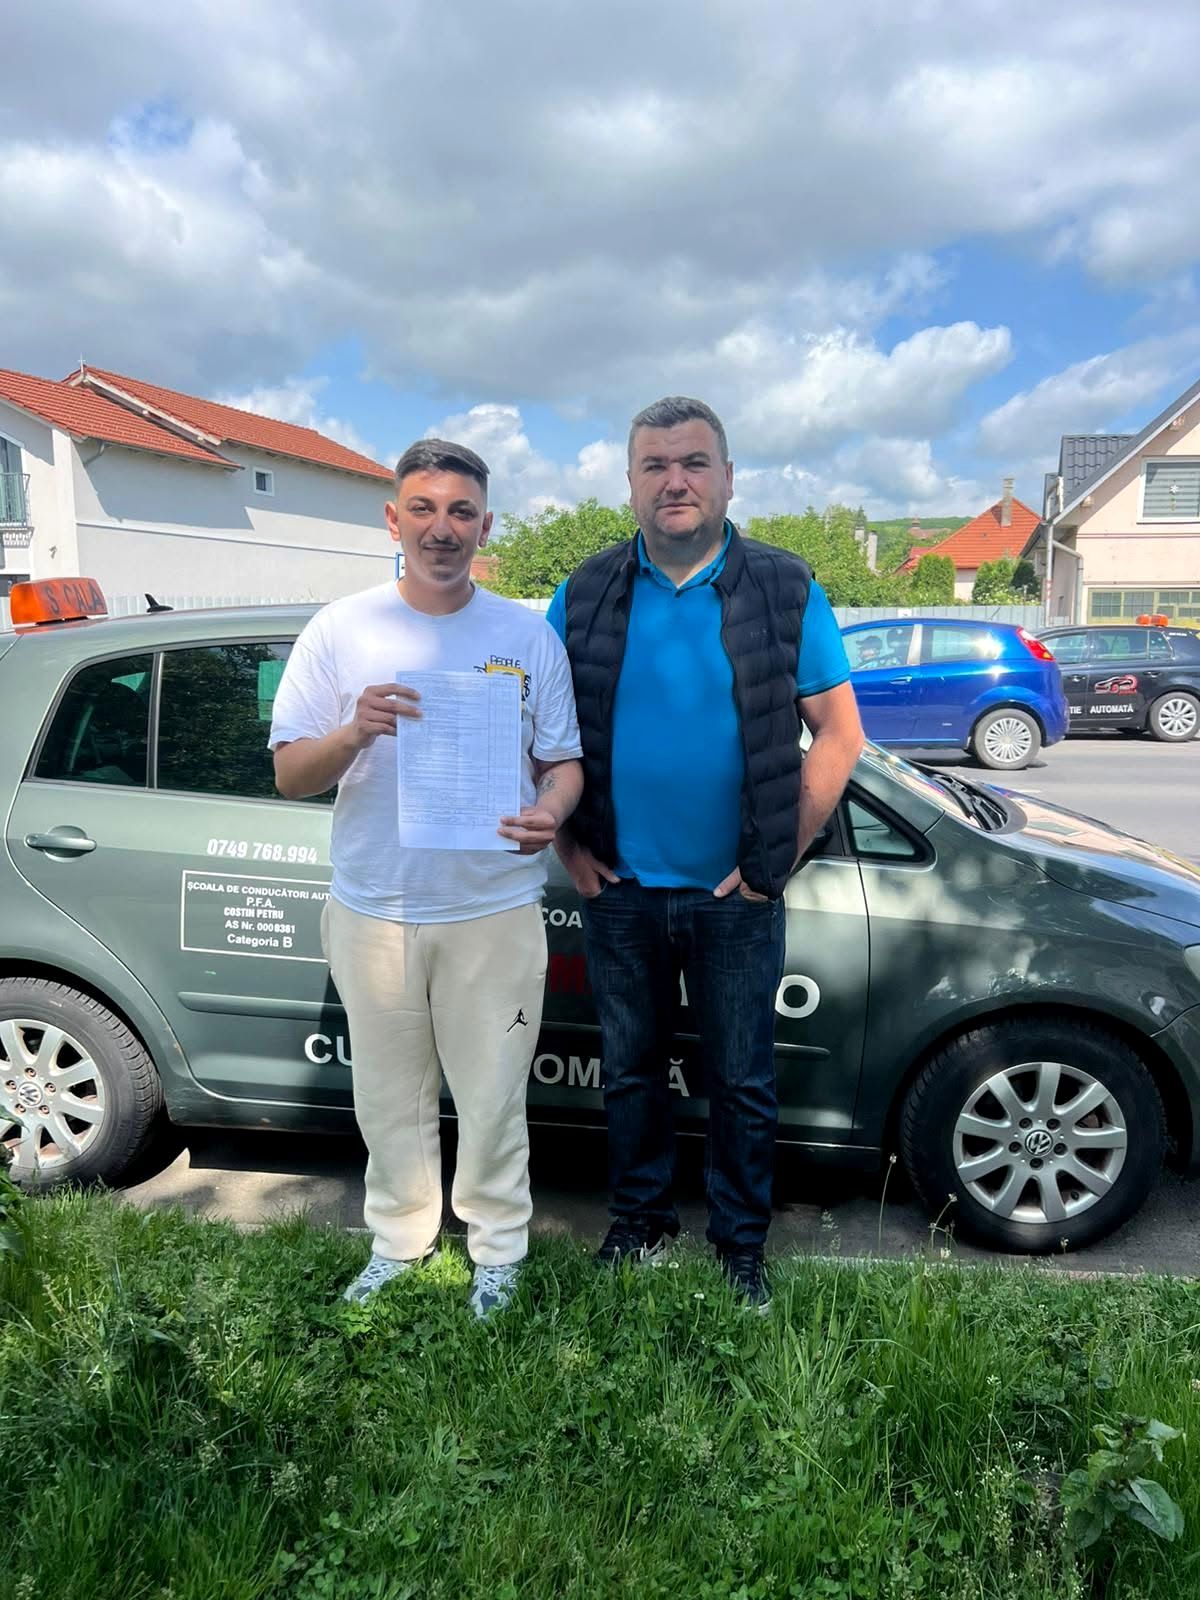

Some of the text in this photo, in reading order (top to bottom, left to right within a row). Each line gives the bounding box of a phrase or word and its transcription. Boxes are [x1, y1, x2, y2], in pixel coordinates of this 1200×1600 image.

[207, 838, 318, 863] 0749 768.994
[226, 885, 239, 893] DE
[311, 892, 332, 900] AUT
[246, 896, 276, 908] P.F.A.
[224, 907, 284, 919] COSTIN PETRU
[225, 920, 239, 929] AS
[241, 921, 255, 931] Nr.
[227, 933, 293, 948] Categoria B
